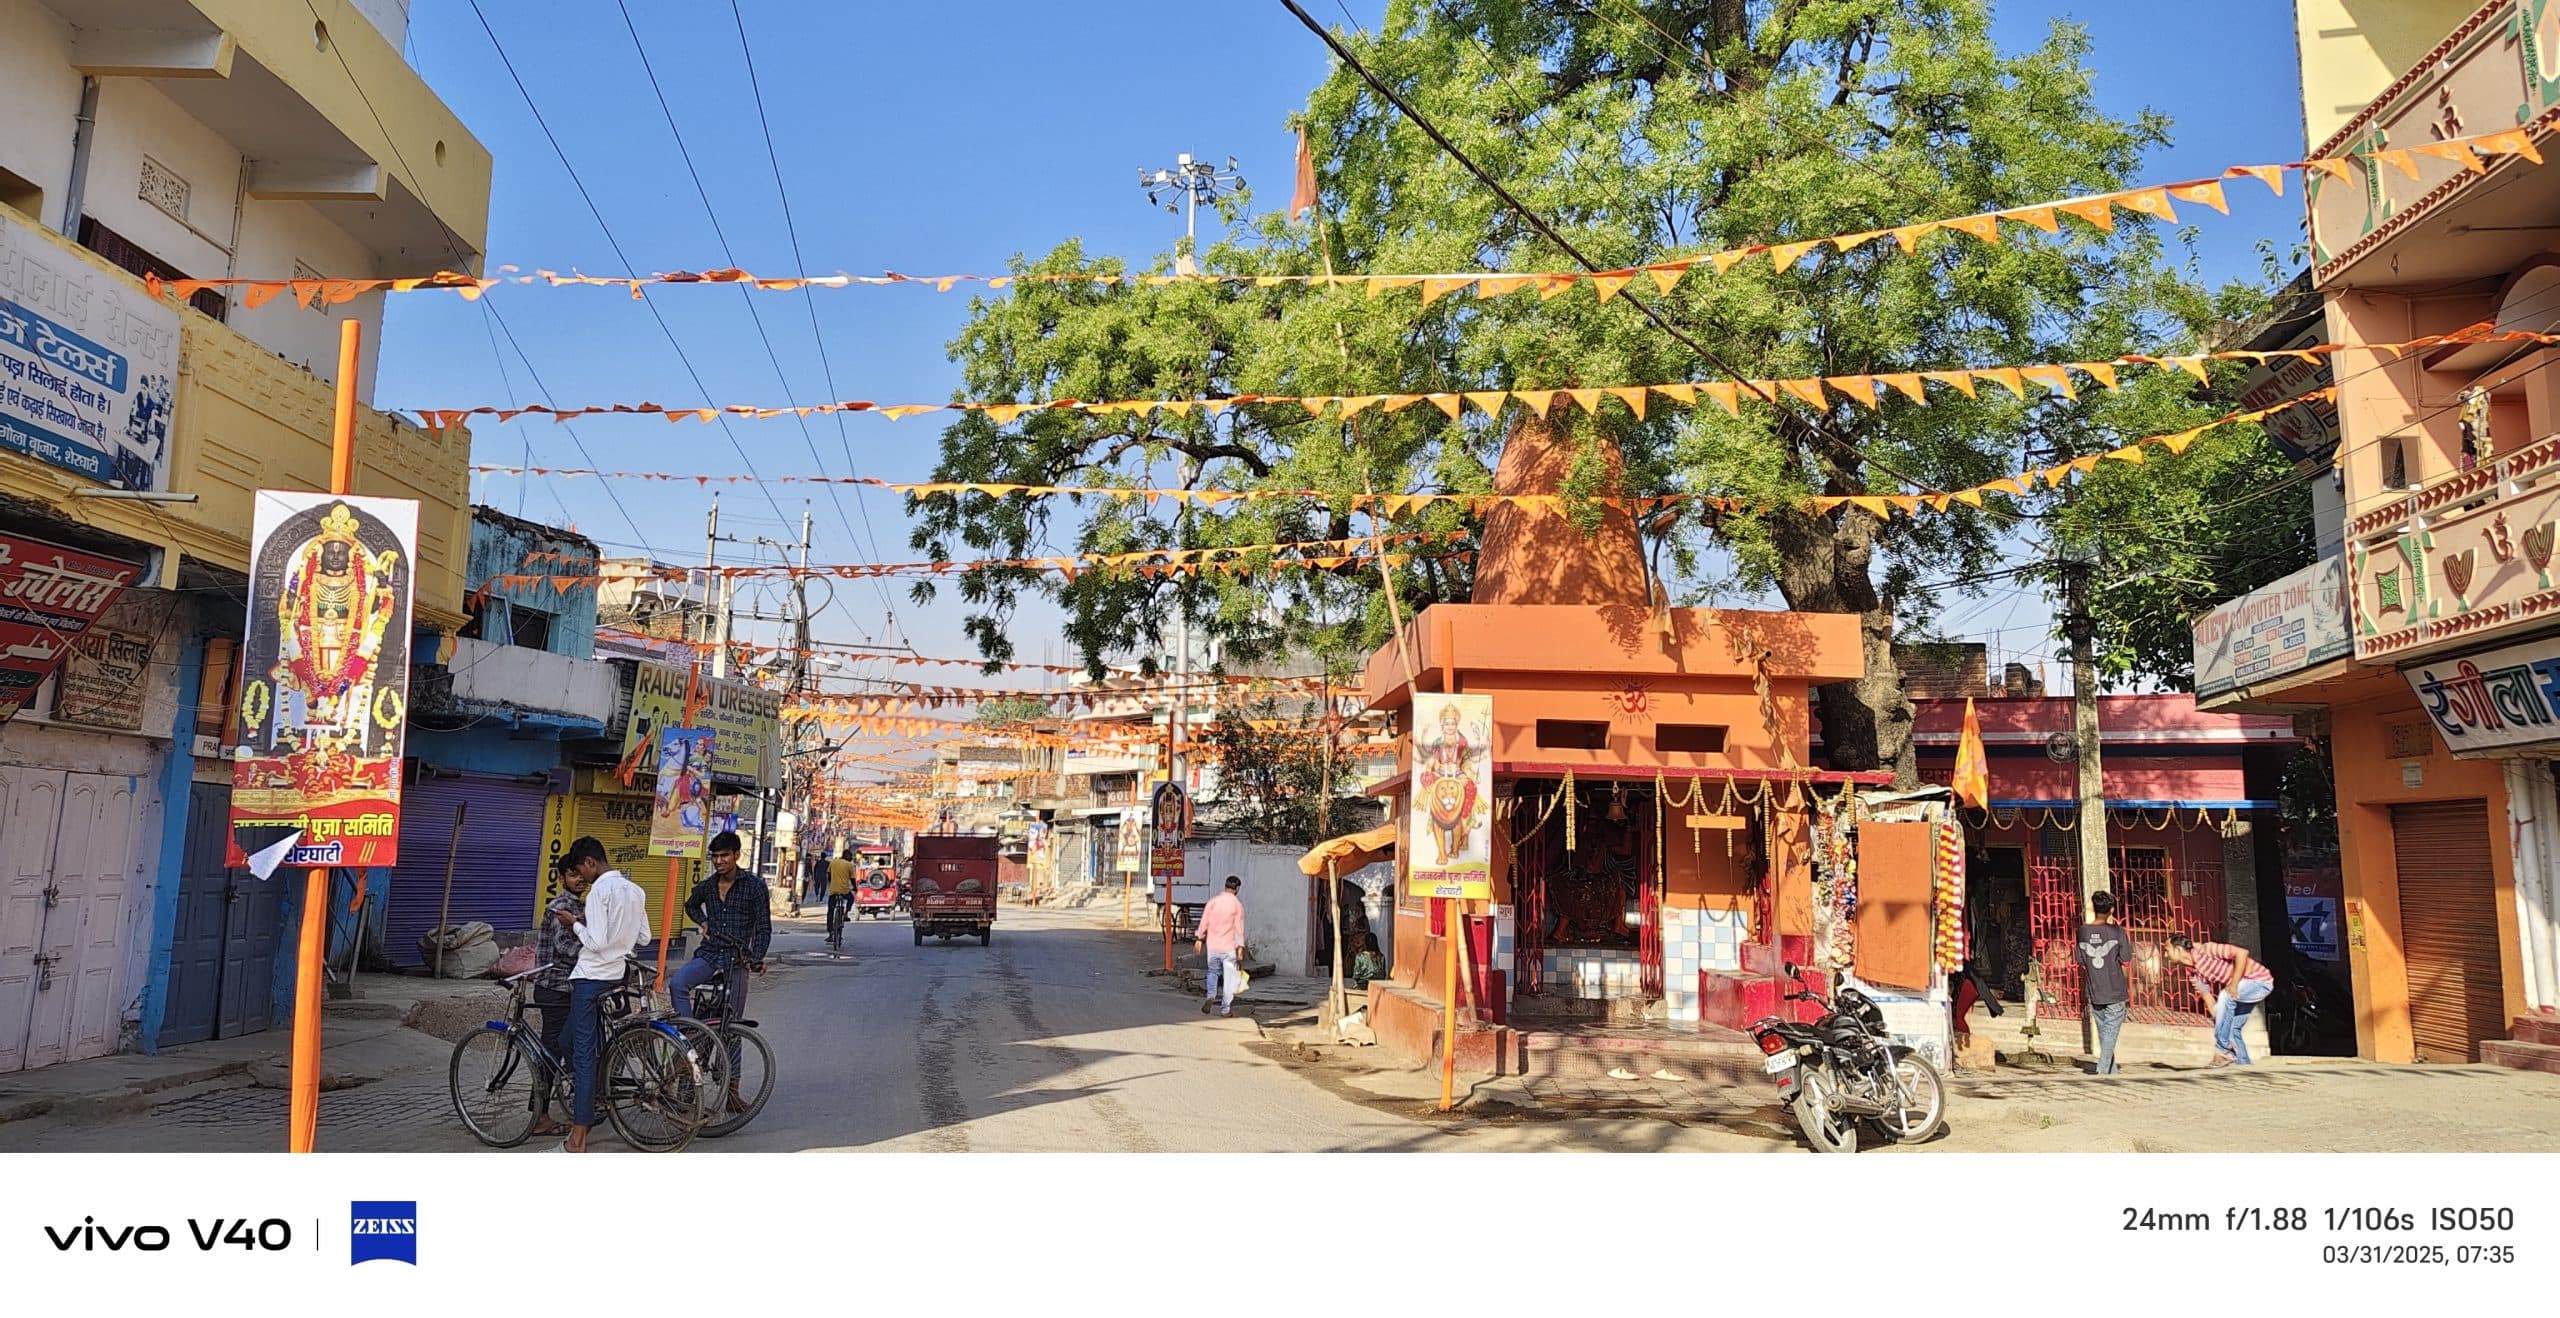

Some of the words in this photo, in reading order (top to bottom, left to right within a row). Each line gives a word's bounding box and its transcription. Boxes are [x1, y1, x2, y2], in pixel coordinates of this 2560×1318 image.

[36, 319, 118, 386] टेलर्स
[0, 353, 25, 381] पड़ा
[28, 361, 69, 398] सिलाई
[70, 382, 95, 409] होता
[46, 400, 77, 432] सिखाया
[2231, 593, 2281, 632] COMPUTER
[2284, 581, 2311, 611] ZONE
[719, 684, 780, 720] DRESSES
[2418, 660, 2551, 736] रंगीला
[311, 817, 341, 842] पूजा
[344, 813, 395, 836] समिति
[1463, 870, 1487, 883] समिति
